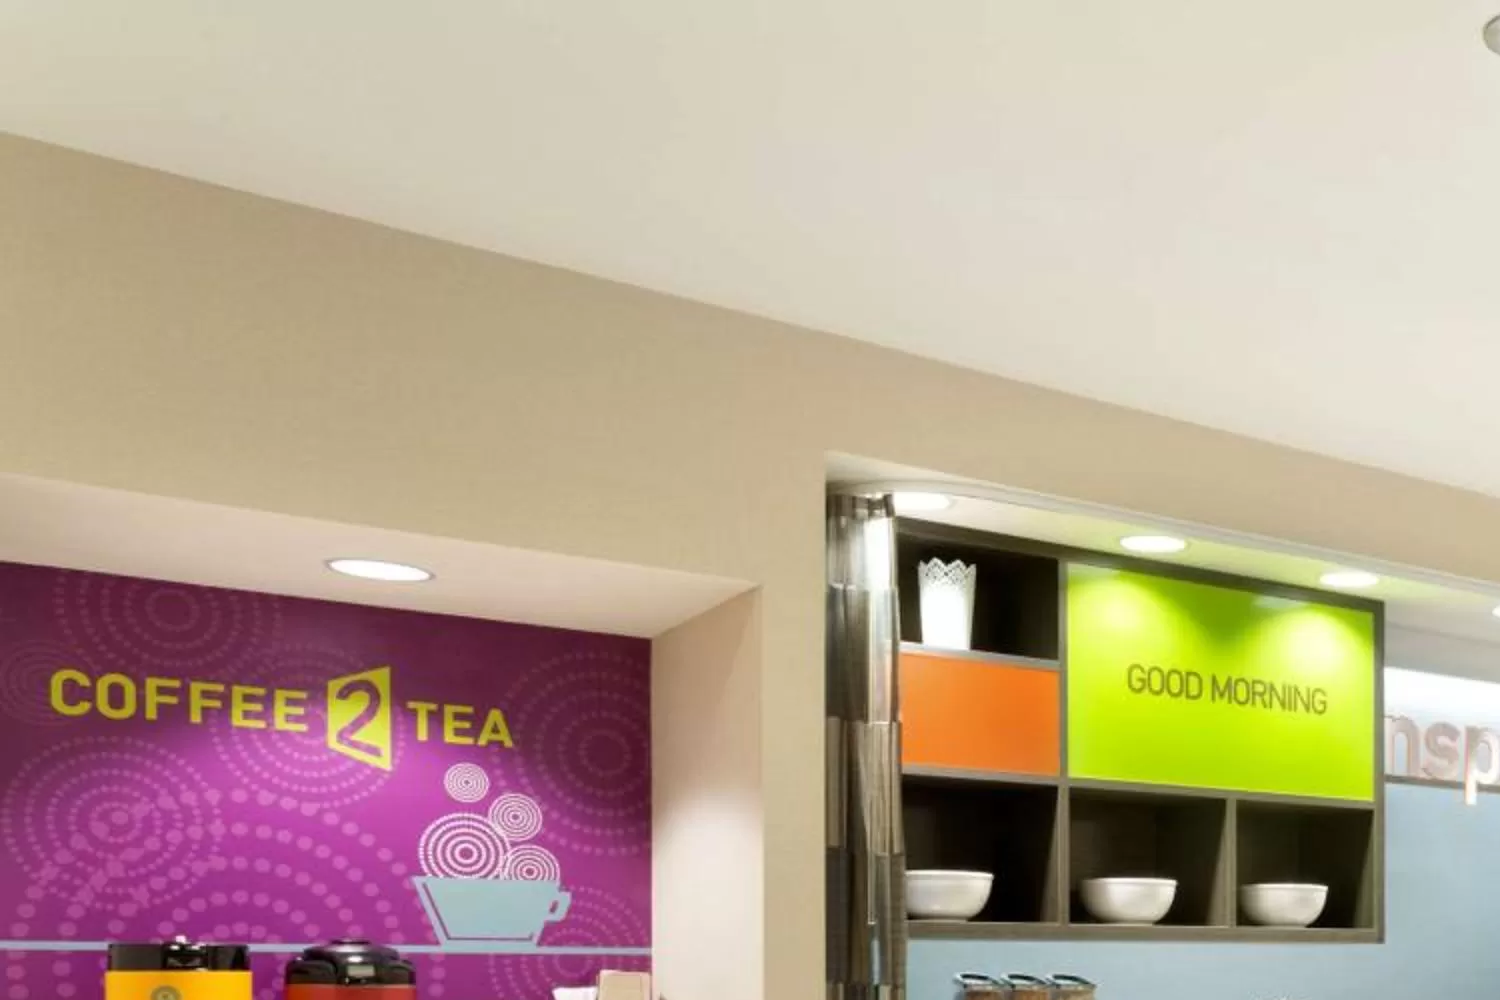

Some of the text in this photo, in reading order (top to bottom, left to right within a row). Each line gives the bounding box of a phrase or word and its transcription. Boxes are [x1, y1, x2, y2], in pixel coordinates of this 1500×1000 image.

[49, 668, 514, 758] COFFEE 2 TEA
[1127, 663, 1328, 715] GOOD MORNING
